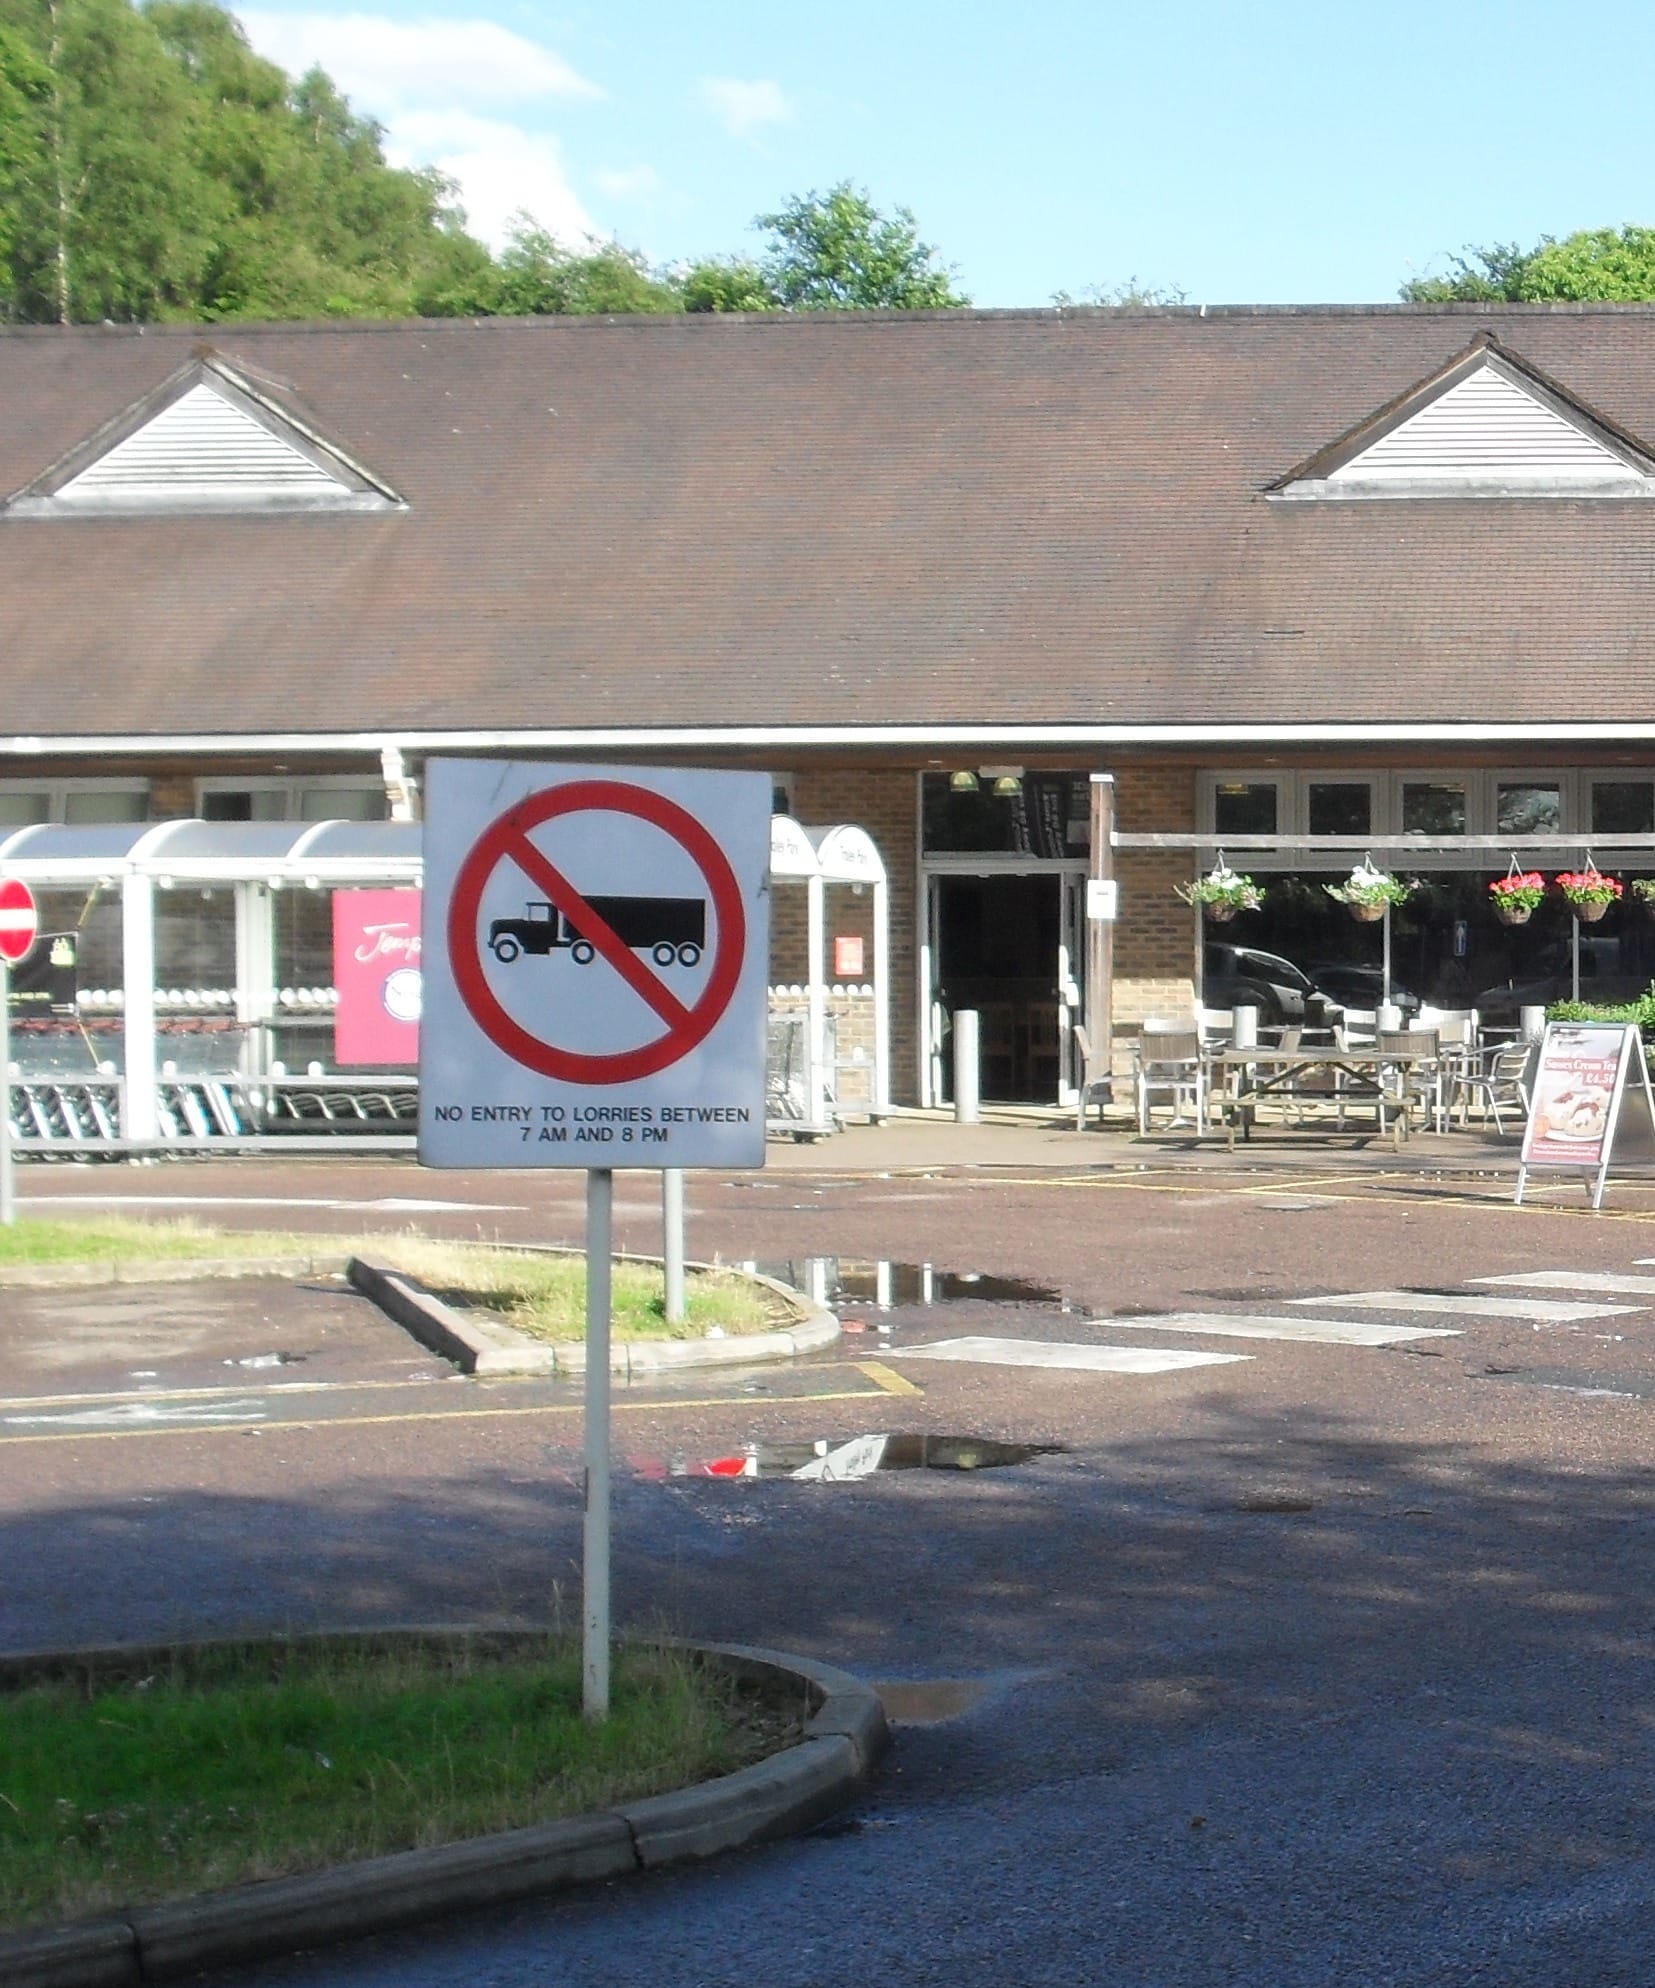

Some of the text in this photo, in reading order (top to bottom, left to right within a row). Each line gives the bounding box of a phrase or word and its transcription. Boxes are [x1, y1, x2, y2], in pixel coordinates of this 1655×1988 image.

[434, 1105, 750, 1123] NO ENTRY TO LORRIES BETWEEN
[519, 1126, 669, 1142] 7 AM AND 8 PM
